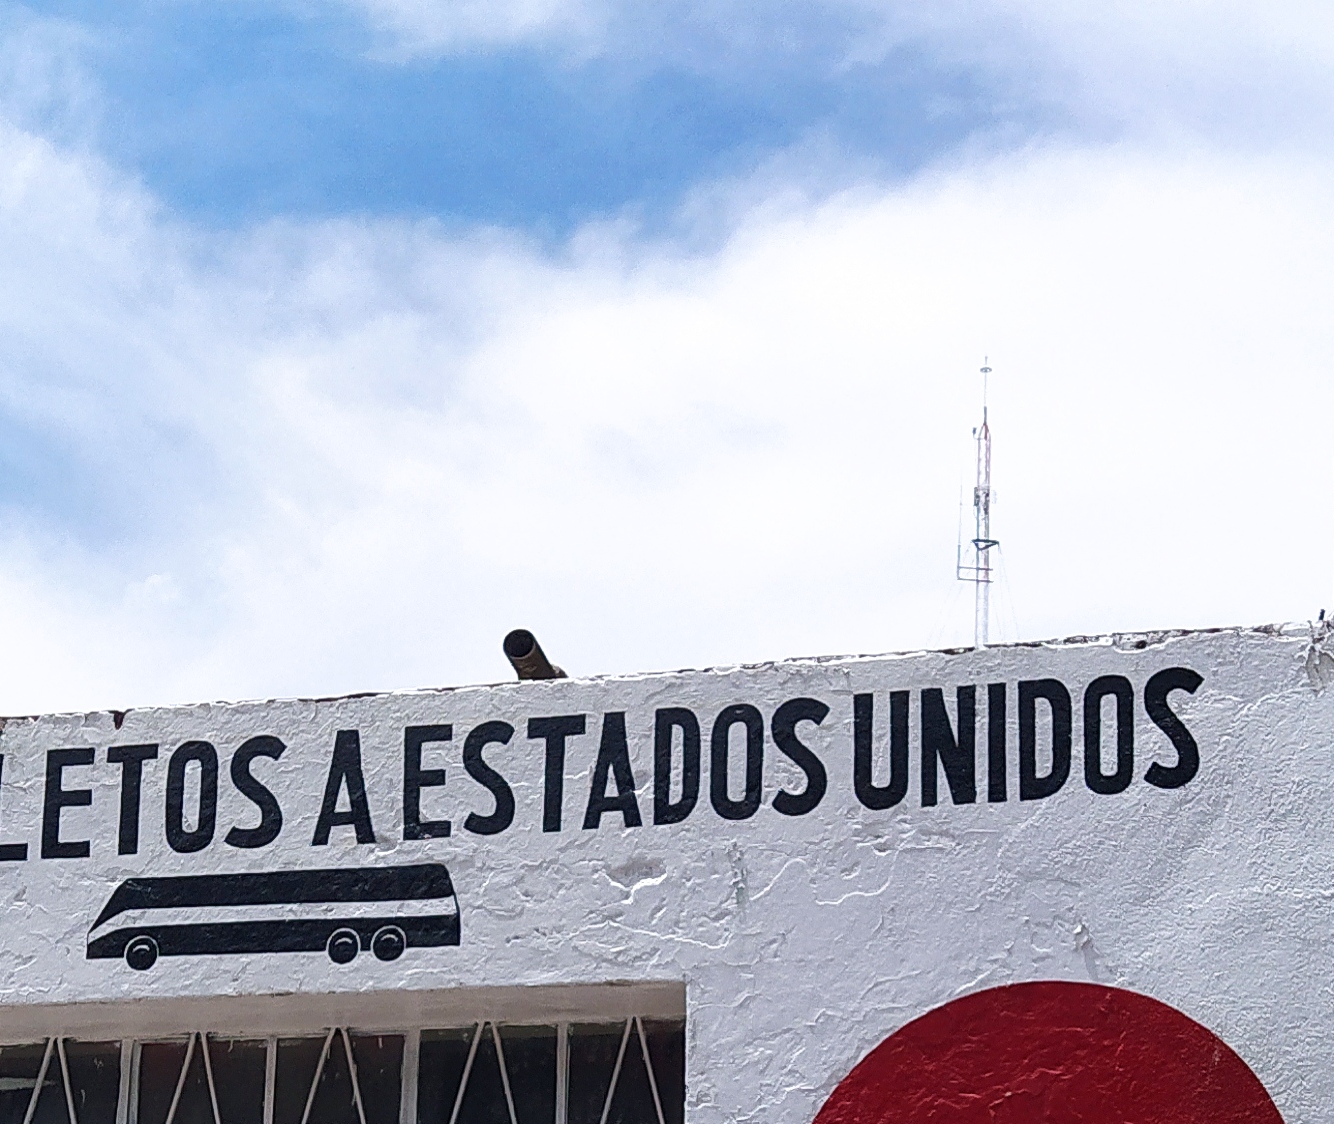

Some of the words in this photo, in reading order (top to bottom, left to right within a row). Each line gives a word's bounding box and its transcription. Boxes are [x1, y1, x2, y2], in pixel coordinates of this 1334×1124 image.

[310, 728, 379, 848] A
[401, 696, 831, 843] ESTADOS
[852, 665, 1206, 812] UNIDOS
